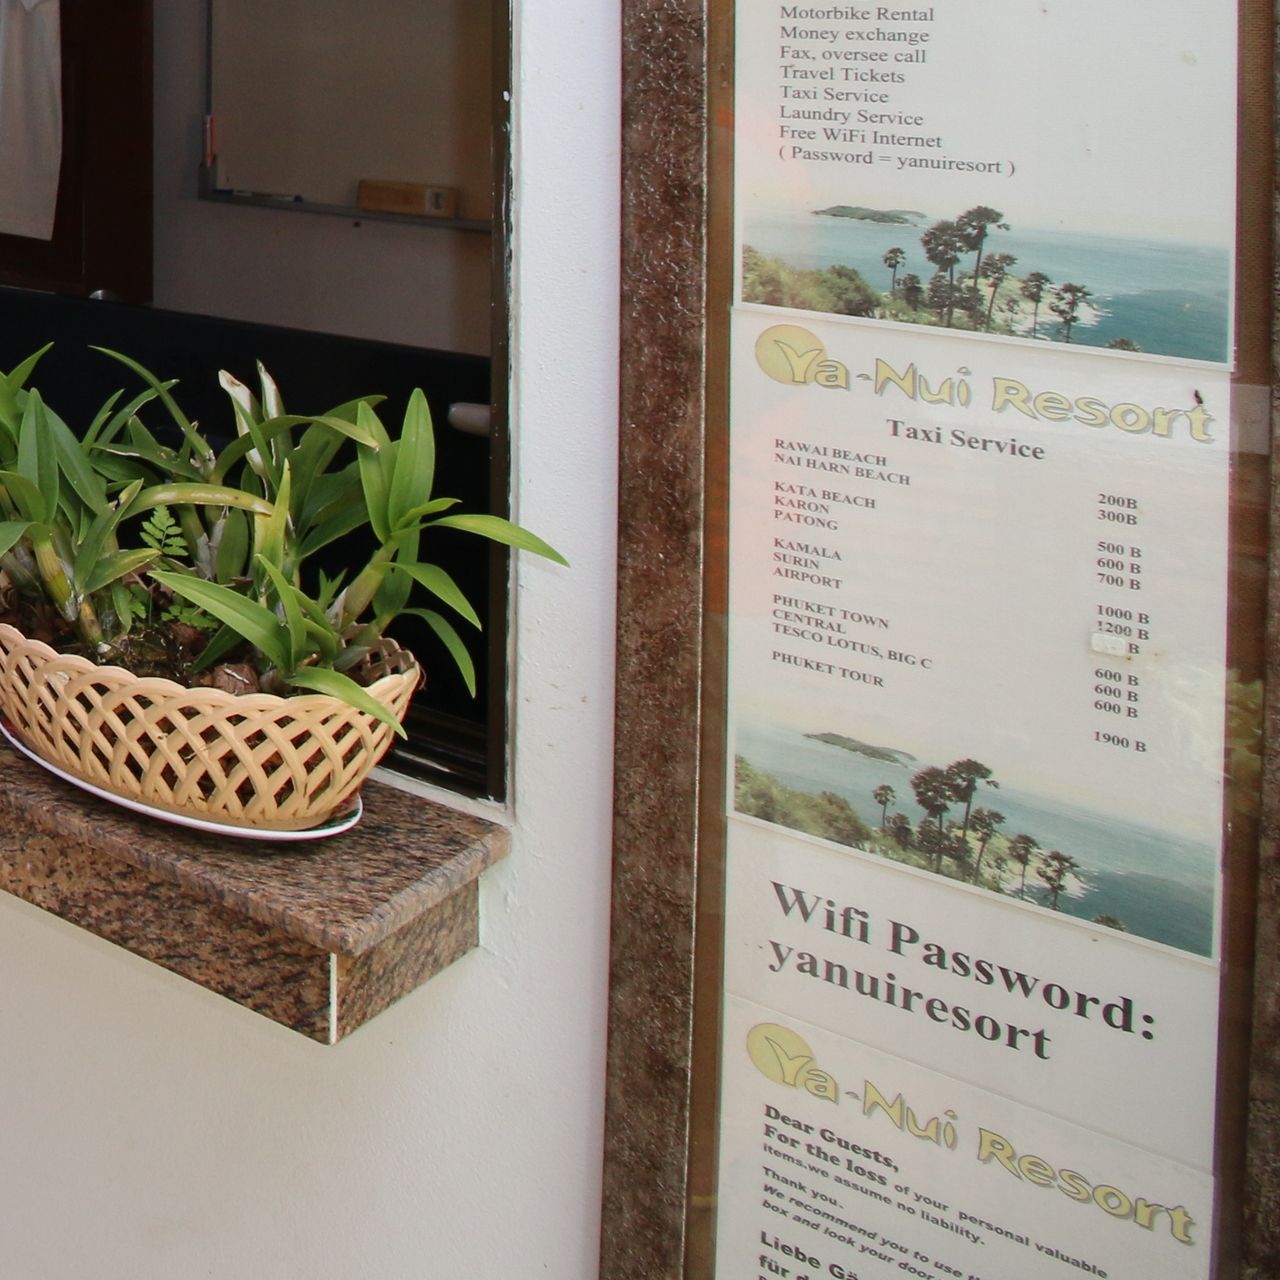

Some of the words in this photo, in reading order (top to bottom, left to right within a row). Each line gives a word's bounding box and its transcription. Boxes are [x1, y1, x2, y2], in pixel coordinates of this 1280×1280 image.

[780, 5, 871, 21] Motorbike
[876, 7, 934, 22] Rental
[780, 25, 840, 44] Money
[845, 27, 930, 46] exchange
[780, 46, 816, 61] Fax,
[822, 50, 888, 62] oversee
[894, 49, 927, 64] call
[780, 65, 834, 81] Travel
[840, 67, 905, 84] Tickets
[780, 85, 817, 100] Taxi
[823, 87, 889, 104] Service
[779, 105, 851, 124] Laundry
[857, 109, 924, 126] Service
[779, 125, 816, 141] Free
[823, 127, 866, 144] WiFi
[872, 130, 943, 149] Internet
[791, 146, 874, 165] Password
[896, 156, 1002, 174] yanuiresort
[773, 340, 973, 407] Ya-Nui
[992, 377, 1217, 443] Resort
[886, 418, 943, 445] Taxi
[950, 429, 1046, 460] Service
[775, 438, 828, 456] RAWAI
[832, 448, 887, 466] BEACH
[774, 452, 801, 466] NAI
[806, 458, 851, 474] HARN
[855, 466, 911, 485] BEACH
[774, 481, 817, 498] KATA
[822, 489, 876, 509] BEACH
[774, 495, 830, 514] KARON
[1098, 493, 1138, 510] 200B
[774, 509, 838, 531] PATONG
[1097, 509, 1138, 525] 300B
[773, 551, 820, 570] SURIN
[774, 537, 842, 561] KAMALA
[1097, 541, 1125, 555] 500
[1130, 546, 1142, 558] B
[1097, 557, 1124, 571] 600
[1130, 562, 1141, 574] B
[773, 567, 843, 589] AIRPORT
[1097, 572, 1124, 587] 700
[1129, 578, 1141, 590] B
[773, 594, 837, 617] PHUKET
[840, 609, 889, 629] TOWN
[773, 608, 847, 634] CENTRAL
[1097, 604, 1133, 621] 1000
[1137, 613, 1150, 624] B
[772, 622, 823, 642] TESCO
[827, 635, 883, 659] LOTUS,
[888, 649, 916, 666] BIG
[920, 658, 933, 669] C
[1138, 629, 1149, 640] B
[1128, 642, 1140, 655] B
[772, 650, 836, 675] PHUKET
[838, 667, 885, 687] TOUR
[1094, 668, 1122, 682] 600
[1127, 674, 1139, 686] B
[1094, 684, 1122, 698] 600
[1127, 690, 1138, 702] B
[1094, 700, 1121, 714] 600
[1127, 706, 1138, 718] B
[1094, 731, 1129, 748] 1900
[1135, 740, 1147, 752] B
[770, 880, 871, 945] Wifi
[887, 919, 1155, 1040] Password:
[768, 939, 1052, 1060] yanuiresort
[764, 1104, 815, 1136] Dear
[819, 1128, 899, 1173] Guests,
[764, 1036, 959, 1151] Ya-Nui
[978, 1126, 1198, 1246] Resort
[761, 1165, 807, 1194] Thank
[811, 1189, 845, 1210] you.
[763, 1123, 801, 1149] For
[806, 1143, 841, 1166] the
[845, 1158, 888, 1186] loss
[894, 1184, 911, 1196] of
[913, 1191, 949, 1212] your
[958, 1210, 1030, 1247] personal
[1034, 1241, 1108, 1280] valuable
[834, 1175, 893, 1205] assume
[896, 1201, 916, 1216] no
[921, 1209, 985, 1246] liability.
[762, 1199, 790, 1218] box
[792, 1213, 821, 1231] and
[824, 1227, 856, 1248] look
[858, 1243, 896, 1264] your
[898, 1261, 936, 1280] door
[763, 1184, 785, 1200] We
[789, 1196, 878, 1241] recommend
[880, 1237, 909, 1255] you
[913, 1250, 929, 1263] to
[934, 1260, 963, 1278] use
[761, 1231, 822, 1270] Liebe
[758, 1254, 791, 1279] für
